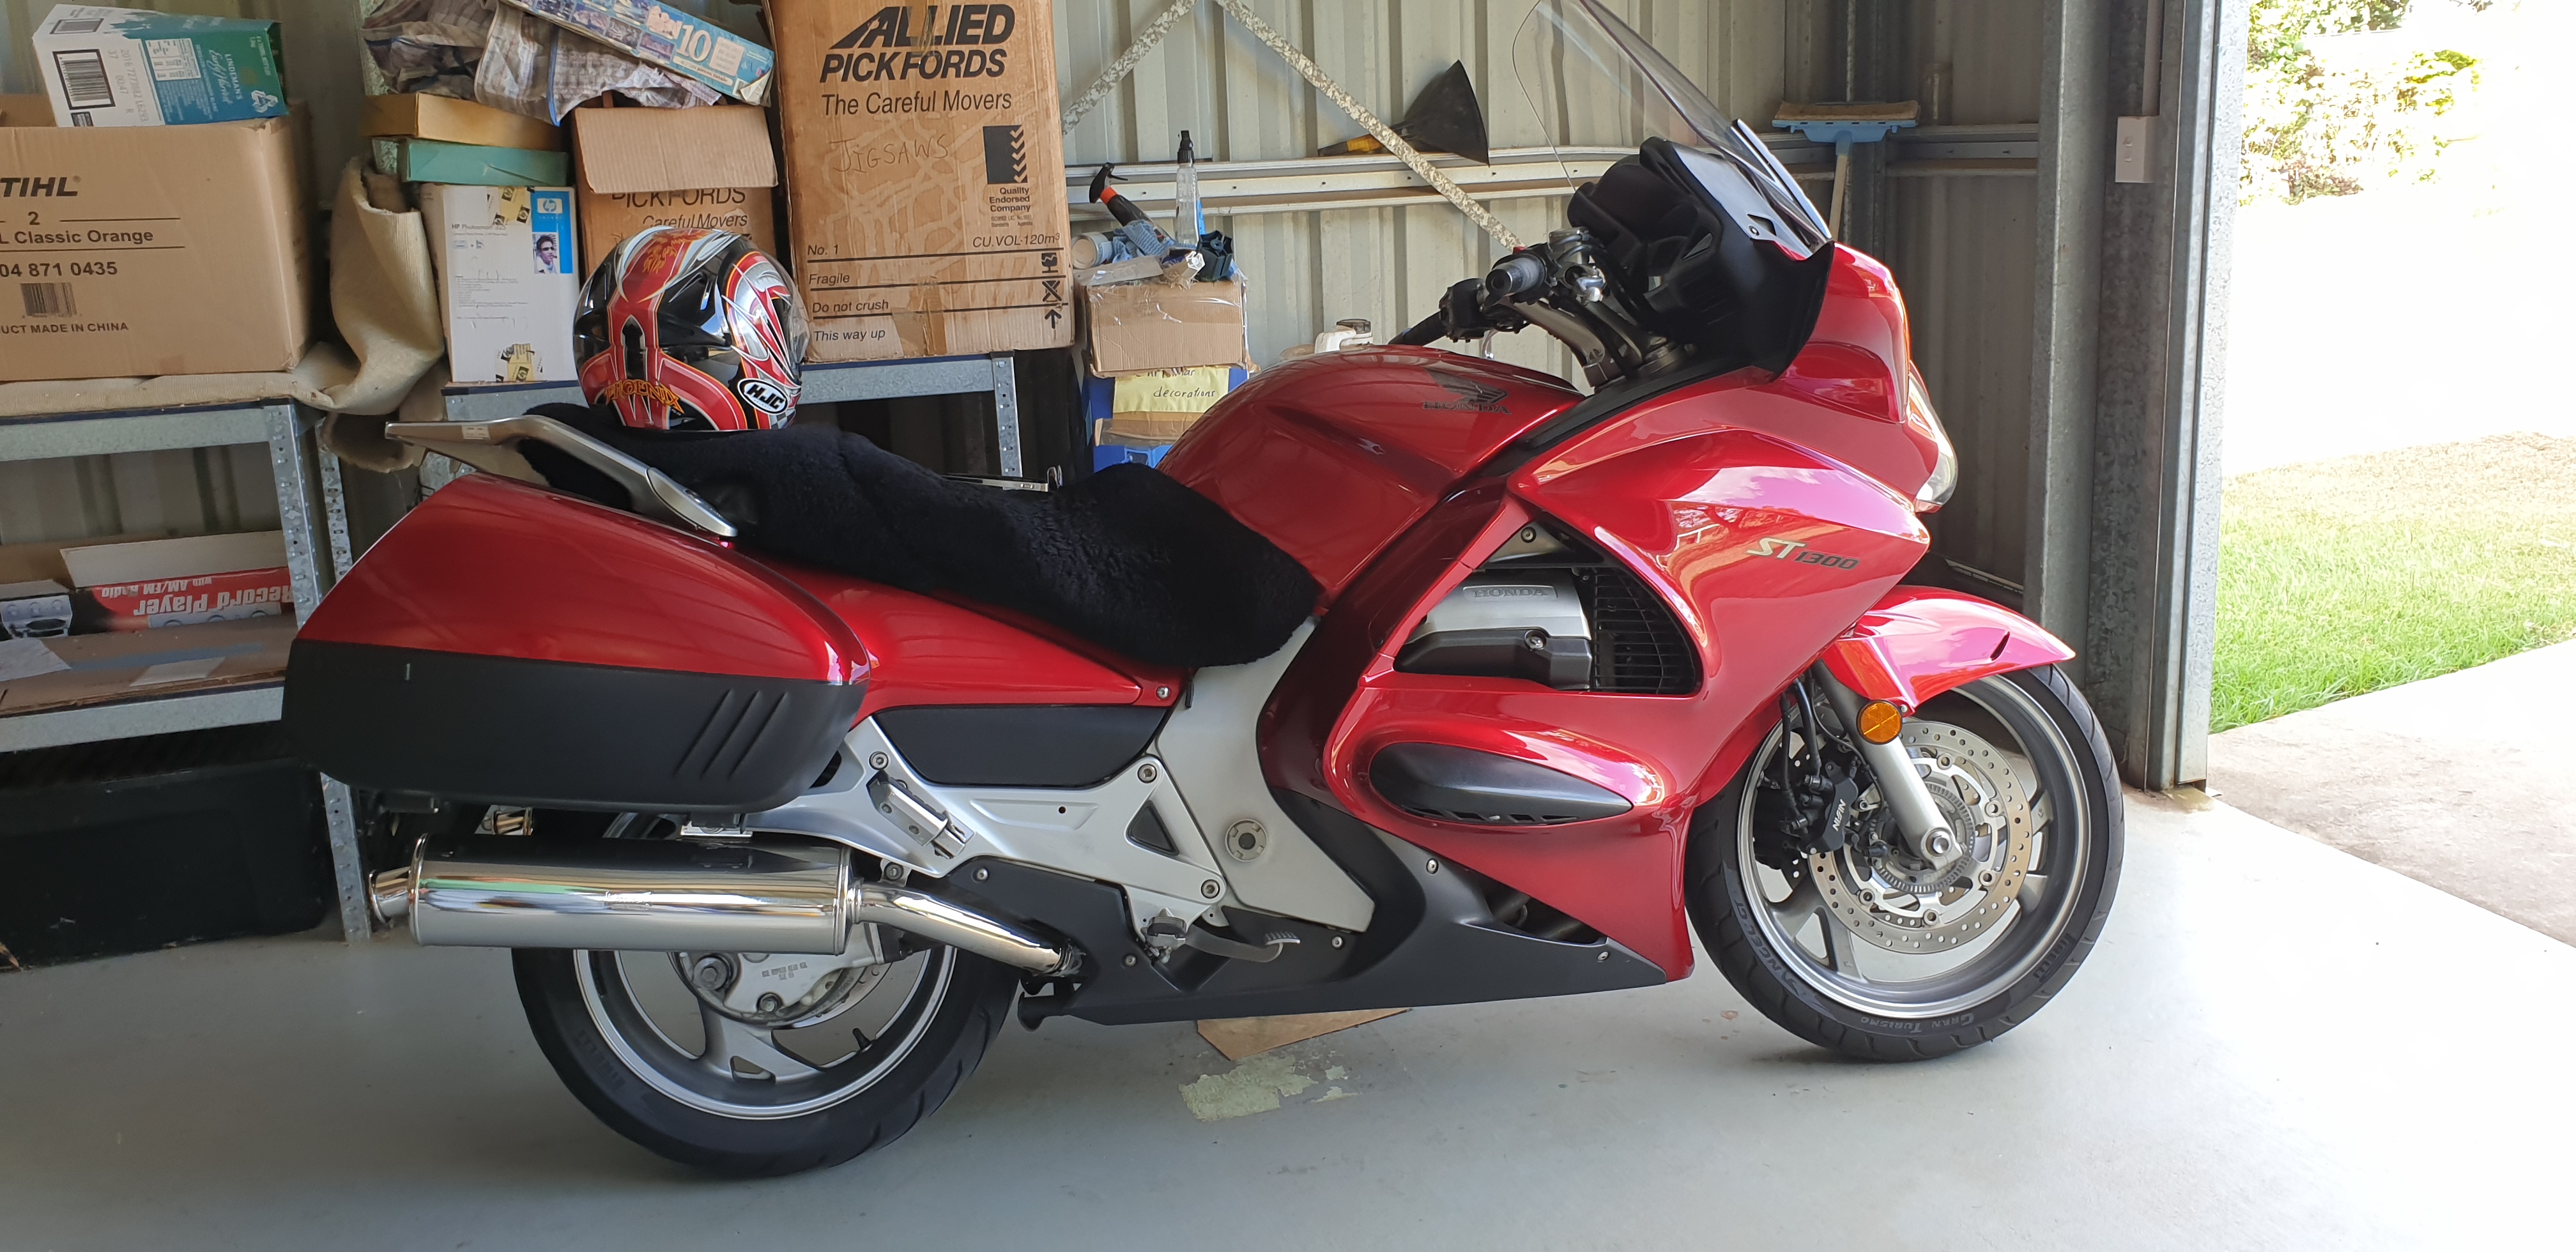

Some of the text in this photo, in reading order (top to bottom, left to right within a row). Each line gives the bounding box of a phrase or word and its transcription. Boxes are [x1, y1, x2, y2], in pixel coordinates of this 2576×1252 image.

[829, 4, 1015, 49] ALLIED
[676, 24, 712, 62] 10
[820, 49, 1008, 83] PICKFORDS
[822, 89, 1012, 116] The Careful Movers
[0, 177, 78, 197] TIHL
[1000, 187, 1030, 195] Quality
[990, 195, 1030, 204] Endorsed
[990, 204, 1031, 213] Company
[27, 211, 40, 225] 2
[698, 213, 748, 228] Movers
[14, 231, 82, 244] Classic
[88, 230, 153, 244] Orange
[808, 245, 838, 256] No. 1
[0, 261, 118, 277] 04 871 0435
[809, 273, 850, 286] Fragile
[813, 300, 889, 313] Do not crush
[0, 322, 129, 334] UCT MADE IN CHINA
[814, 330, 885, 342] This way up
[747, 384, 785, 410] HJC
[1153, 386, 1215, 397] decorations
[1422, 401, 1512, 415] HONDA
[1746, 537, 1860, 570] ST 1300
[143, 580, 190, 595] AM/FM
[1472, 588, 1549, 598] HONDA
[134, 586, 293, 616] Record Player
